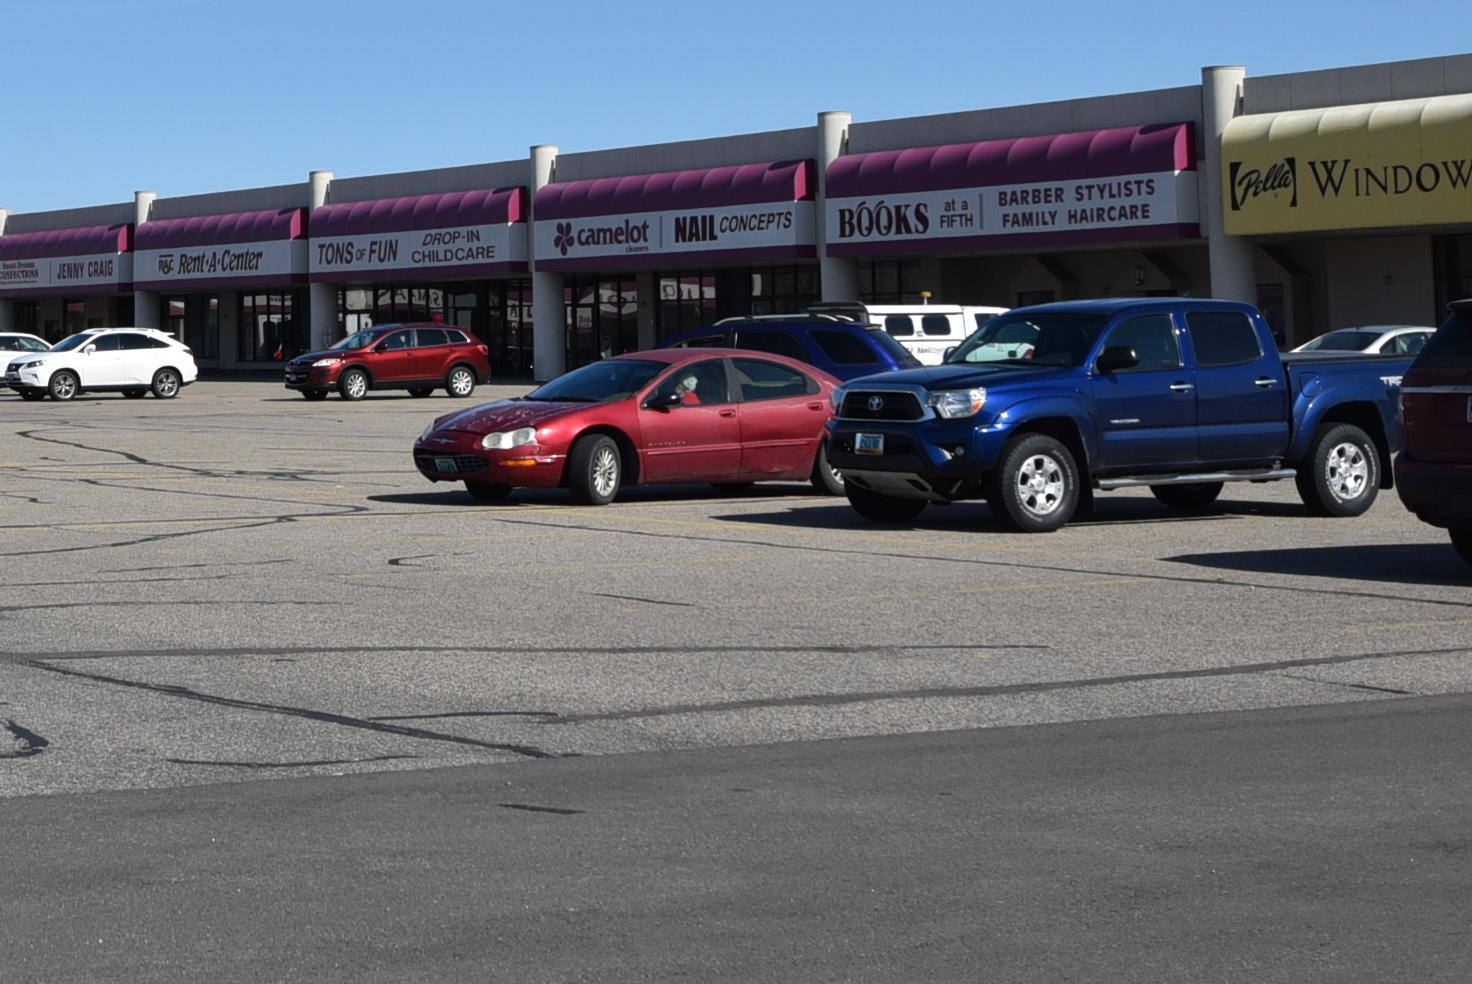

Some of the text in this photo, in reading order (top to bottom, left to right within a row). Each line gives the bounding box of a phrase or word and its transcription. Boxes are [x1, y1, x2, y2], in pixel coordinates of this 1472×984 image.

[998, 179, 1156, 207] BARBER STYLISTS
[1237, 163, 1293, 207] Pella
[943, 198, 969, 212] at a
[1002, 203, 1151, 228] FAMILY HAIRCARE
[674, 211, 793, 244] NAIL CONCEPTS
[838, 200, 930, 238] BOOKS
[939, 213, 974, 229] FIFTH
[422, 230, 481, 247] DROP-IN
[576, 219, 650, 246] camelot
[318, 239, 399, 265] TONS OF FUN
[411, 245, 496, 264] CHILDCARE
[57, 259, 114, 280] JENNY CRAIG
